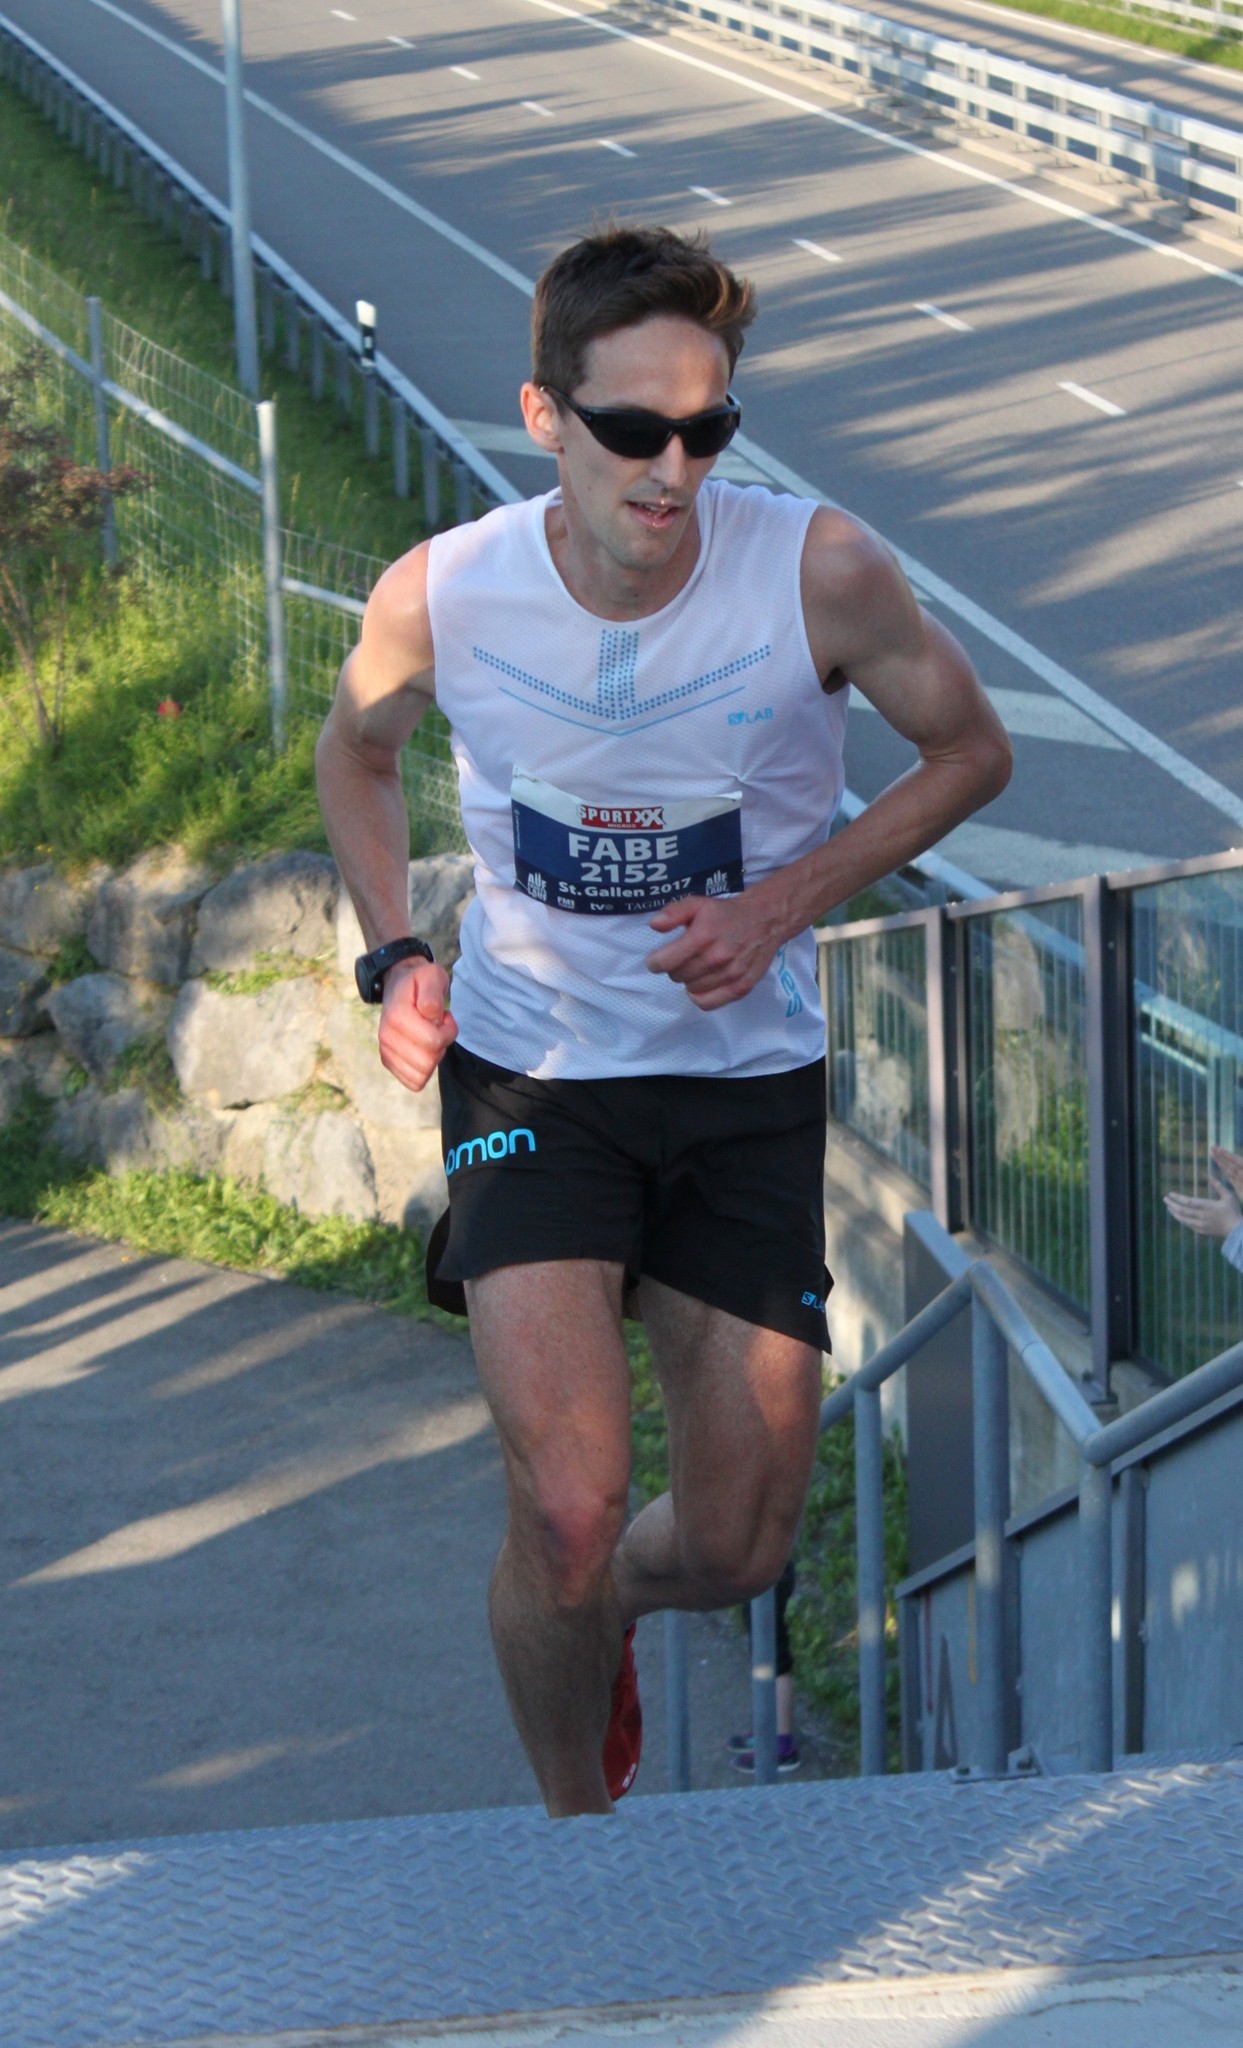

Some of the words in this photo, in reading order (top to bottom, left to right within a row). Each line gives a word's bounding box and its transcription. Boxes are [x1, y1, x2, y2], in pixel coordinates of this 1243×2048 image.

[568, 832, 679, 862] FABE
[580, 862, 669, 884] 2152
[558, 880, 582, 896] St.
[584, 886, 646, 898] Gallen
[649, 876, 692, 896] 2017
